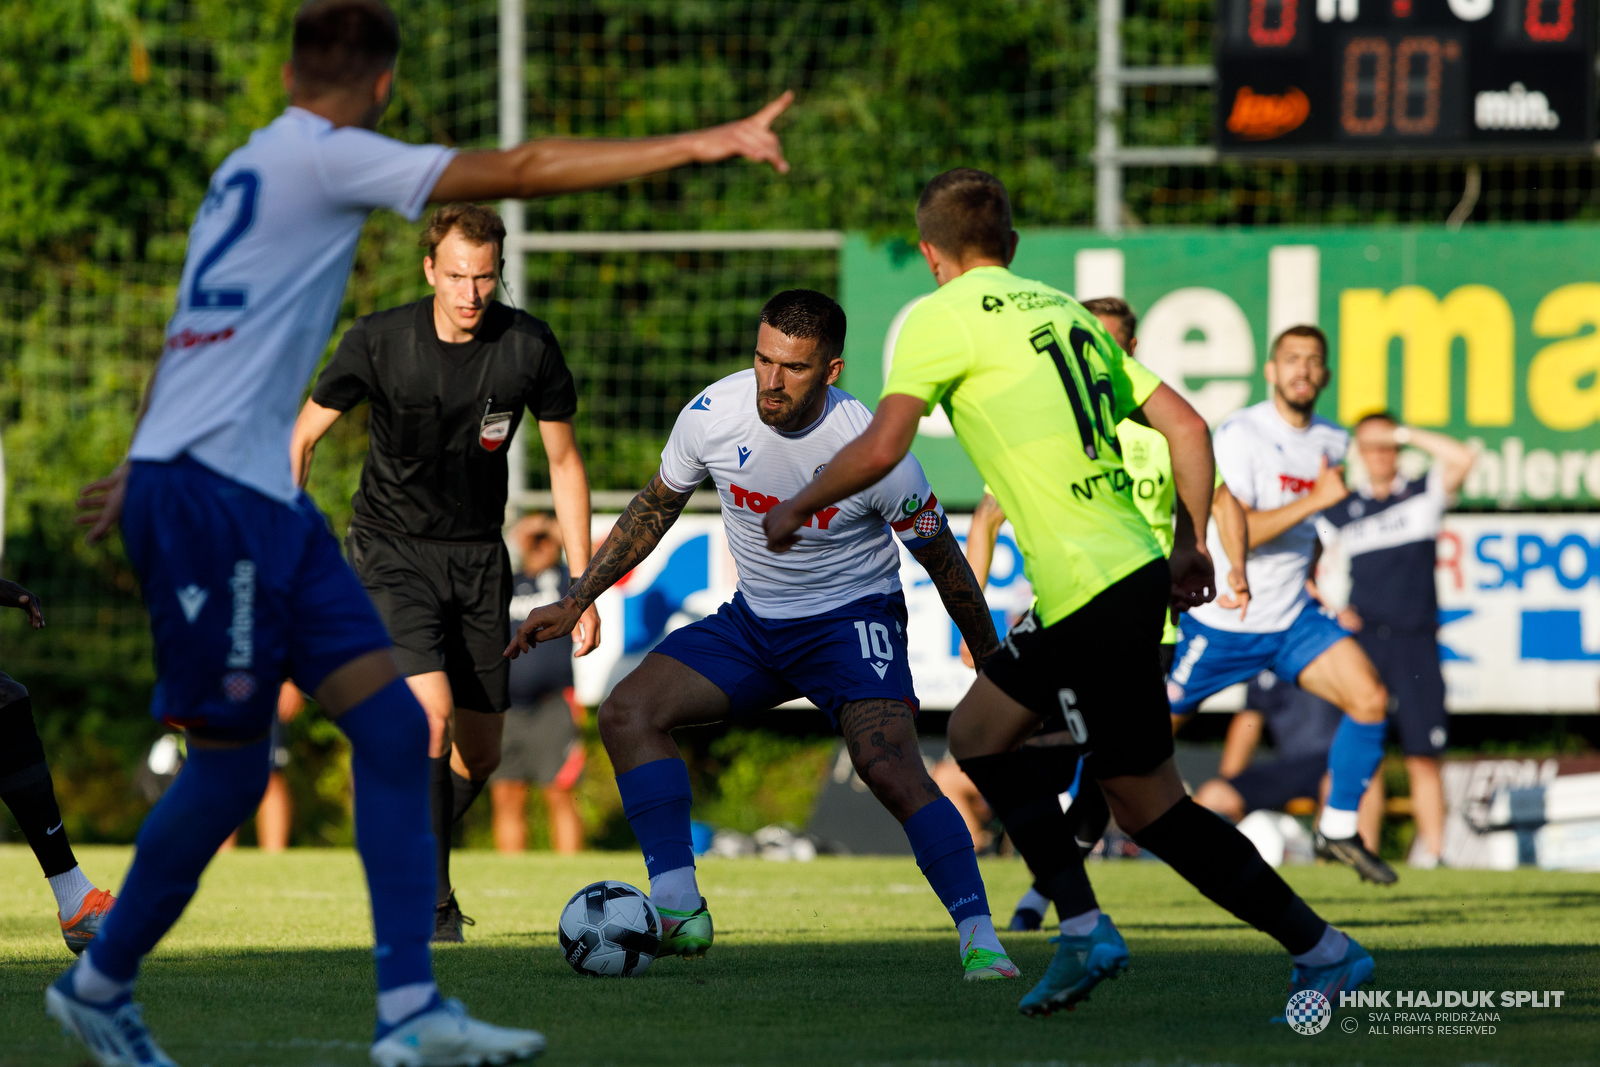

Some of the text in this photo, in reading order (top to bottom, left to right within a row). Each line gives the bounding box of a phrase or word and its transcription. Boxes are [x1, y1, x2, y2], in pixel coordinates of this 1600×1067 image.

[1475, 82, 1560, 130] min.
[730, 483, 840, 530] TOMY
[1436, 531, 1600, 590] RSPO
[854, 621, 894, 661] 10
